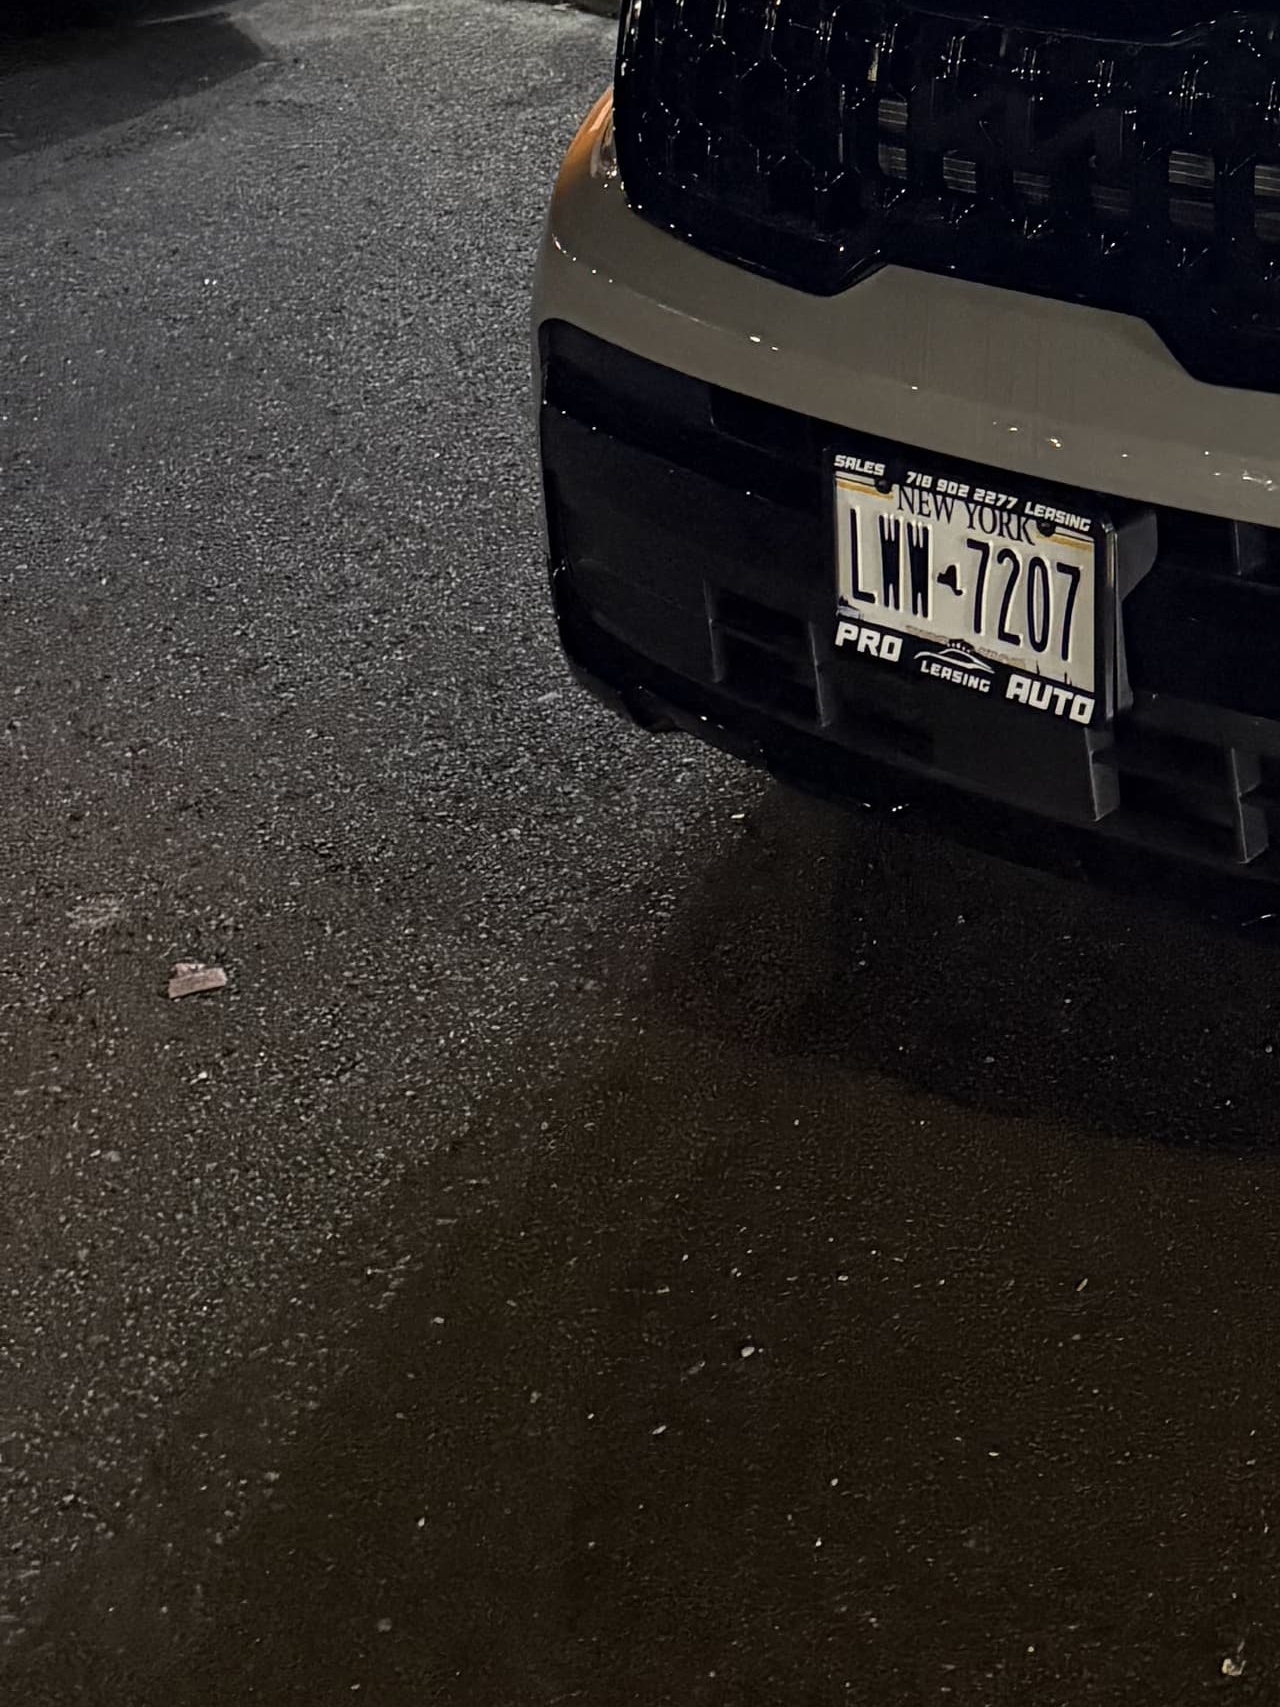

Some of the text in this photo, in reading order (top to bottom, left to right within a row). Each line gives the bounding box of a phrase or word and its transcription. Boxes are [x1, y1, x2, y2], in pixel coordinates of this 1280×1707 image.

[834, 454, 886, 477] SALES
[905, 471, 1018, 511] 718 902 2277
[896, 485, 1035, 546] NEW YORK
[1024, 501, 1092, 533] LEASING
[849, 505, 1083, 664] LWW 7207
[834, 621, 904, 663] PRO
[920, 659, 991, 694] LEASING
[1005, 672, 1095, 726] AUTO
